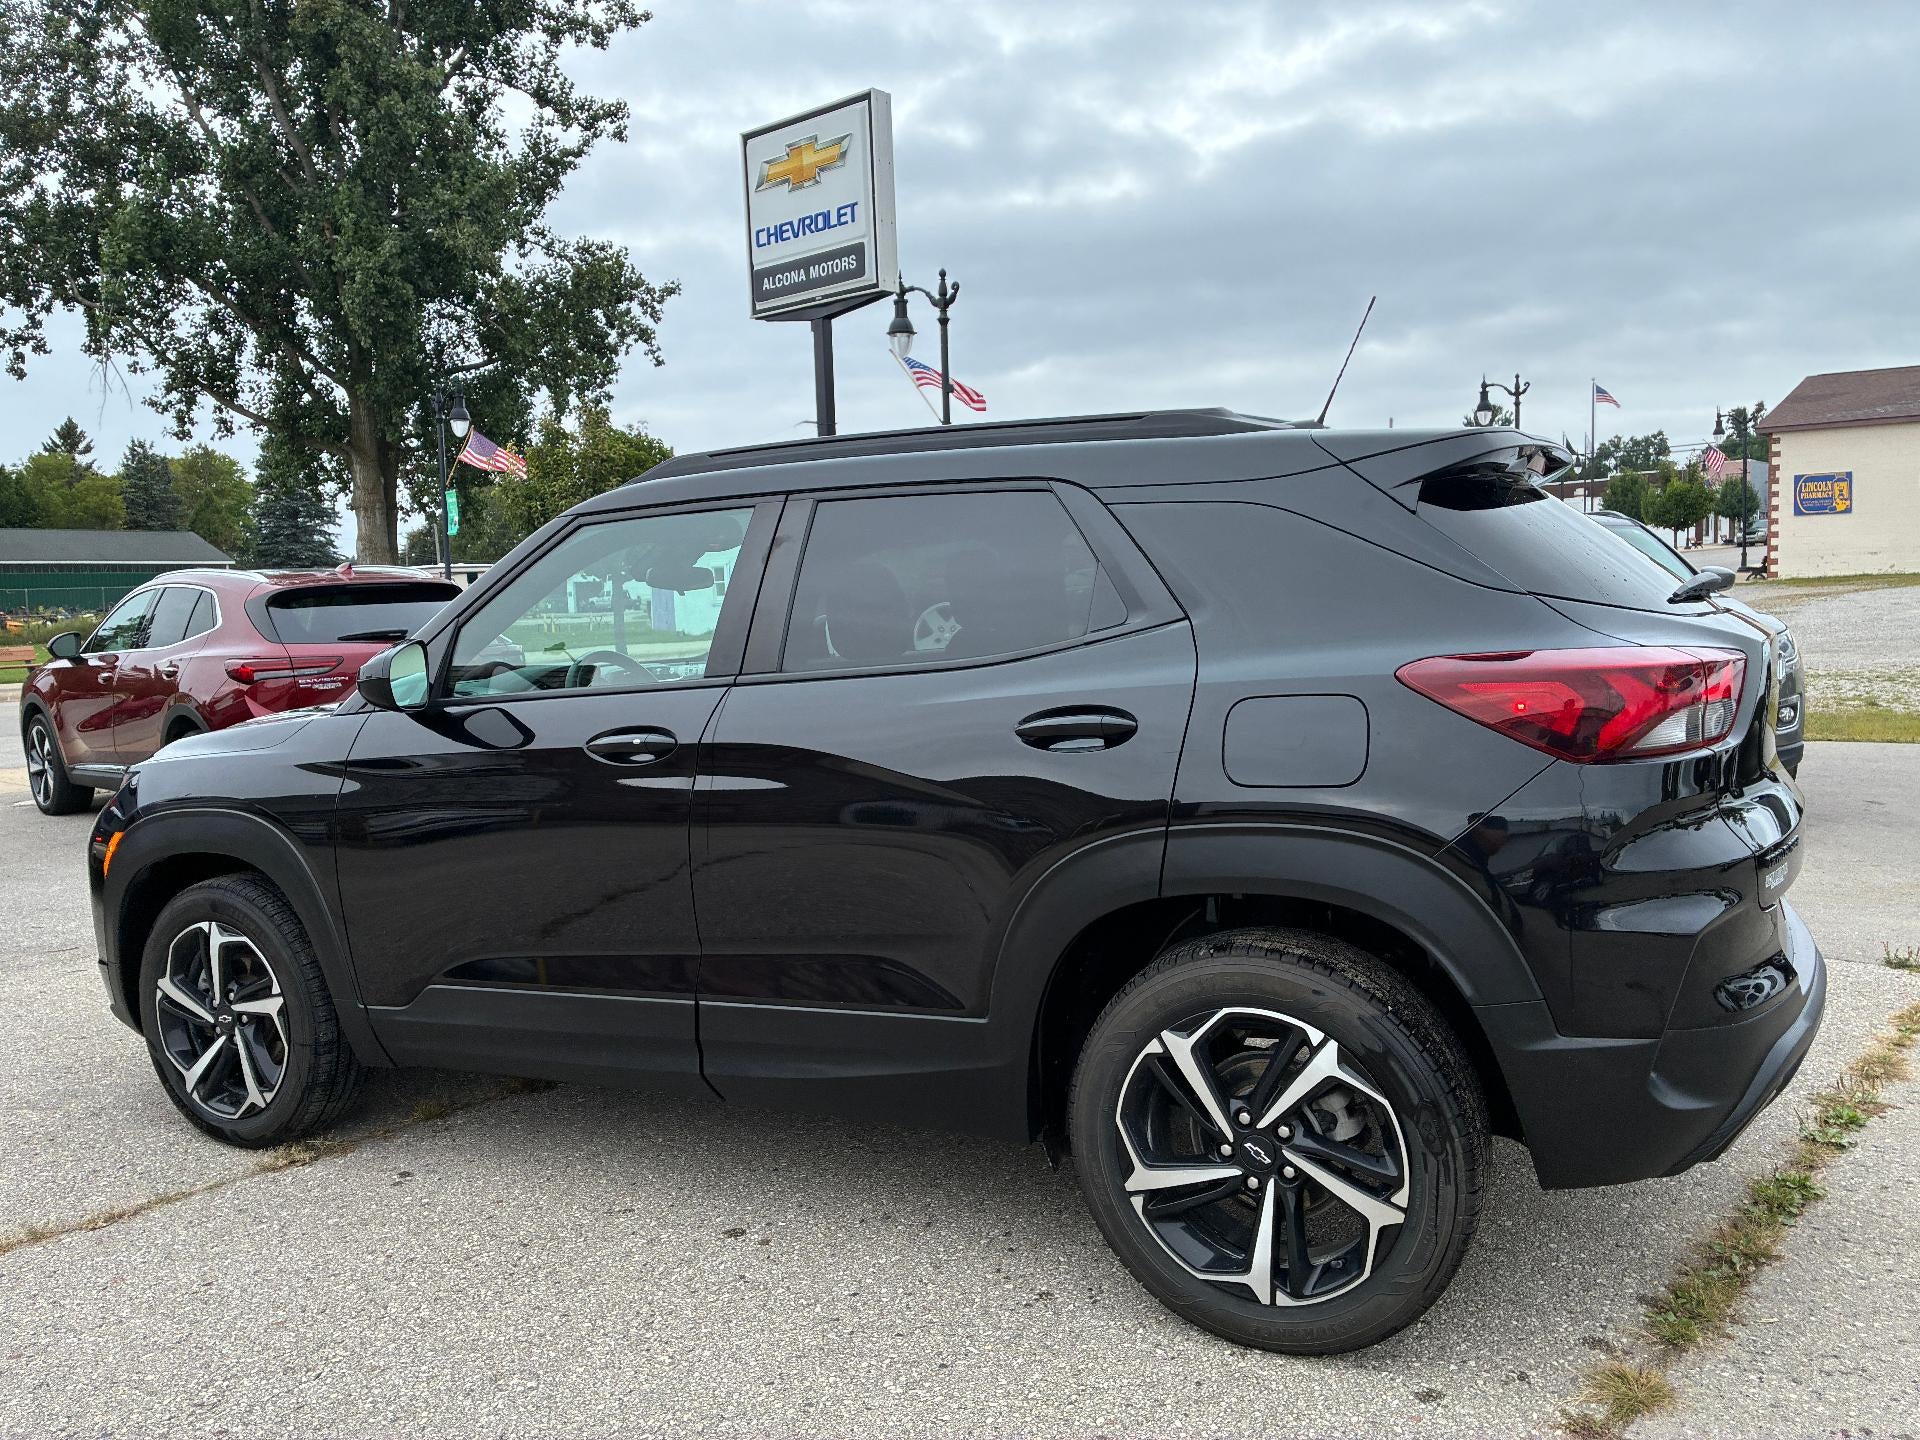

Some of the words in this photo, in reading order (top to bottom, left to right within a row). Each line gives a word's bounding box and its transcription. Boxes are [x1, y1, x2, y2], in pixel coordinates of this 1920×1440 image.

[755, 201, 858, 248] CHEVROLET
[762, 268, 806, 291] ALCONA
[809, 254, 857, 280] MOTORS
[1802, 481, 1832, 492] LINCOLN
